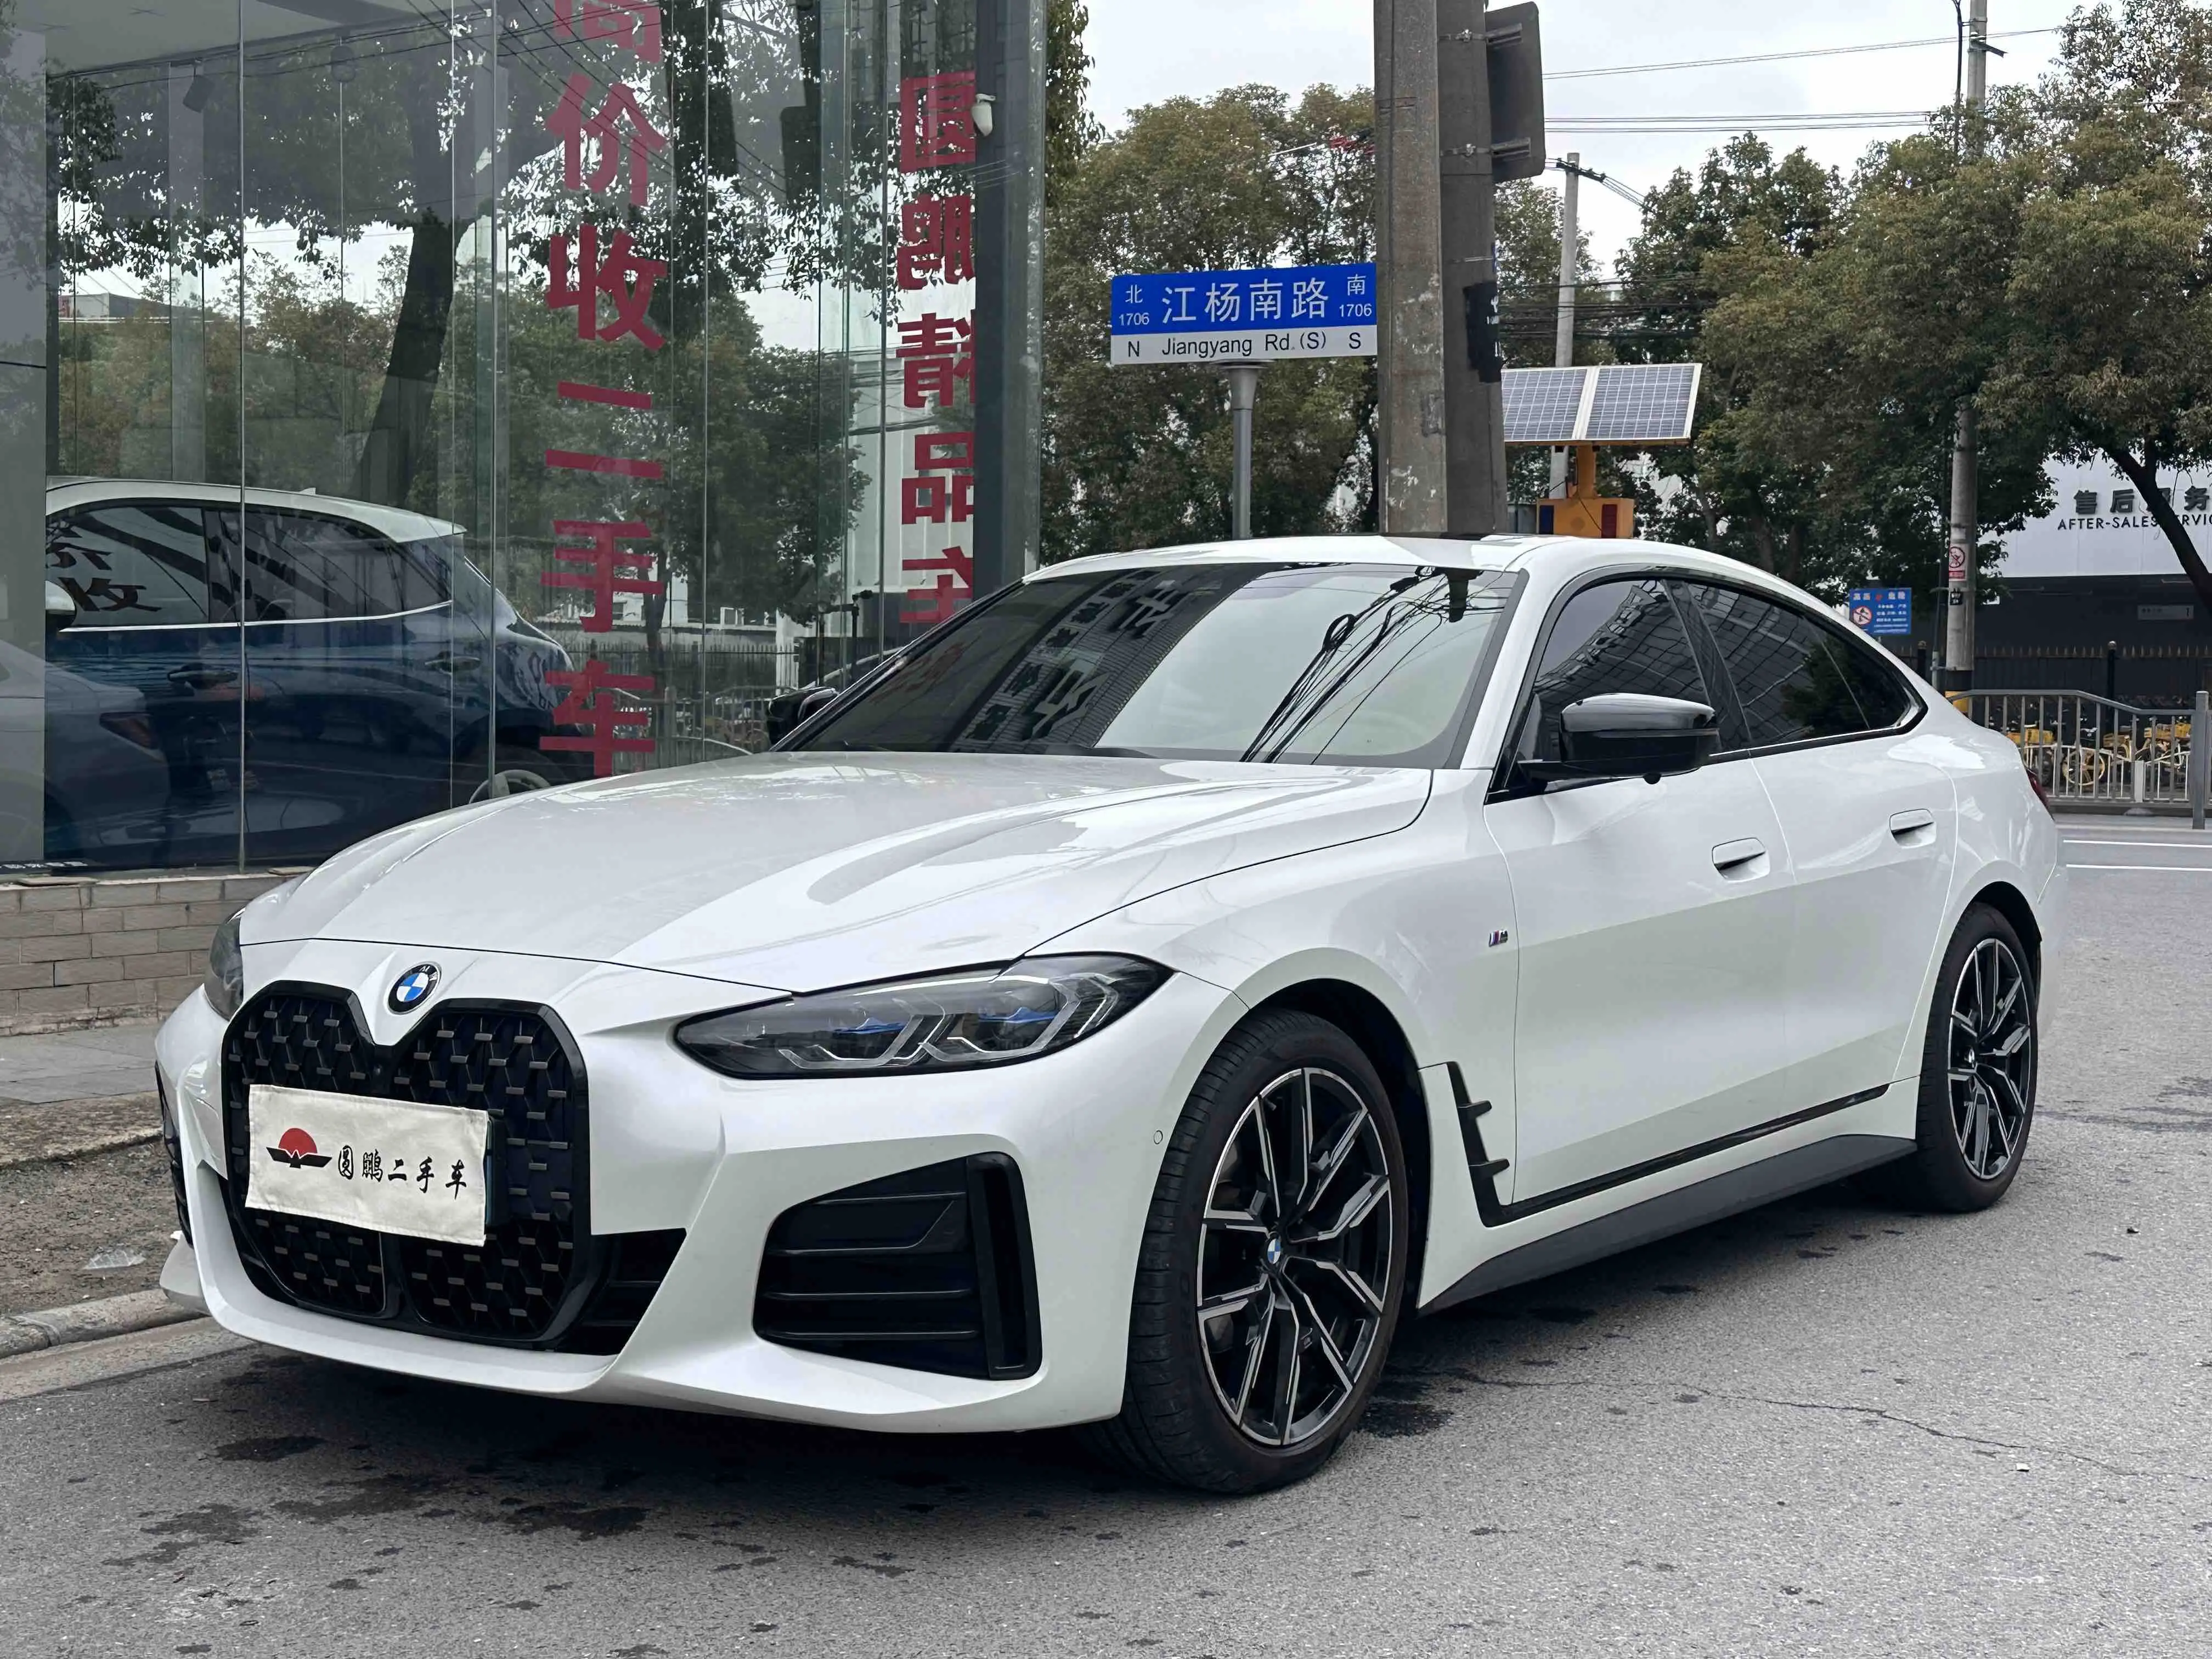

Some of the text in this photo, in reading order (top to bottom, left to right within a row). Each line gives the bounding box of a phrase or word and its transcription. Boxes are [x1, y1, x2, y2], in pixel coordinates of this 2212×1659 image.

[1125, 285, 1143, 303] 北
[1347, 274, 1366, 296] 南
[1161, 277, 1329, 324] 江杨南路
[1339, 303, 1372, 318] 1706
[1119, 312, 1149, 326] 1706
[1128, 341, 1140, 358] N
[1162, 337, 1252, 358] Jiangyang
[1348, 332, 1361, 349] S
[2073, 486, 2210, 514] 售后务
[2057, 515, 2158, 530] AFTER-SALES
[338, 1145, 467, 1200] 圆鹏二手车
